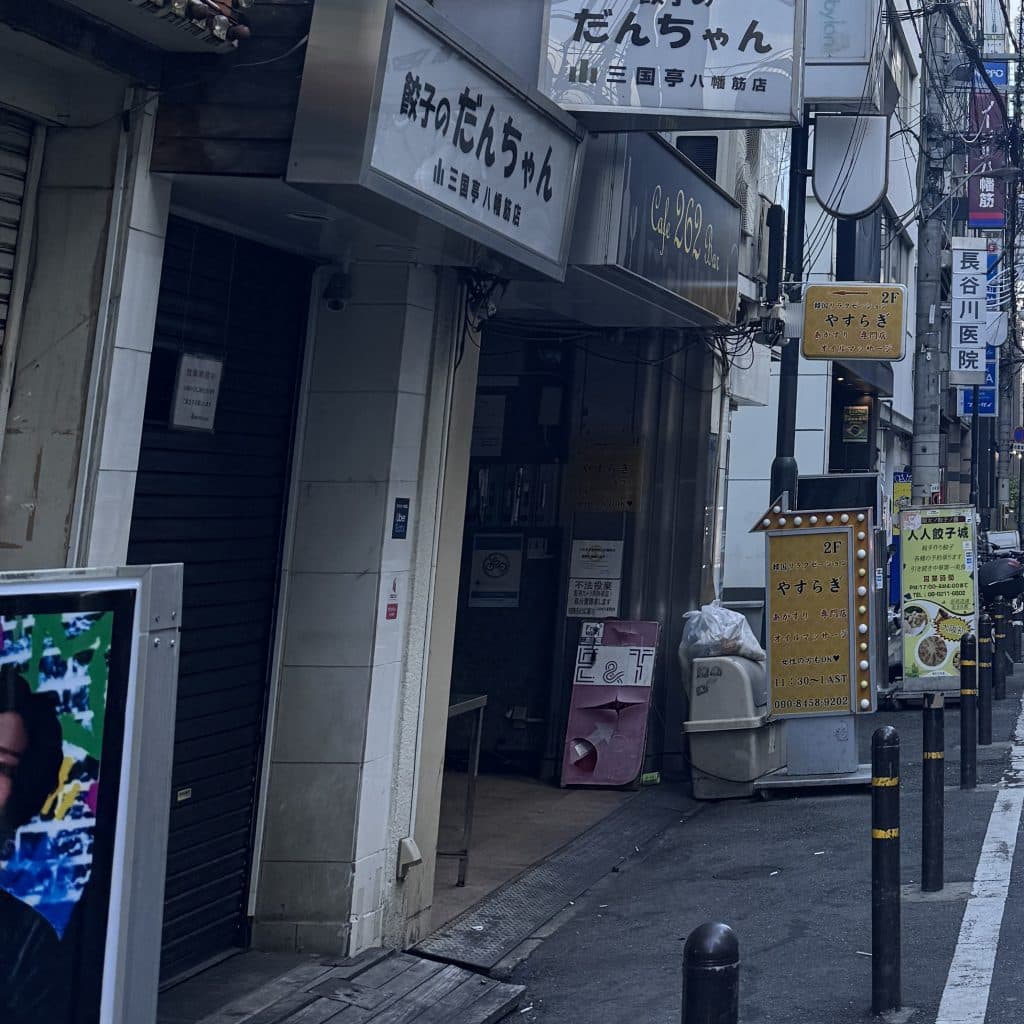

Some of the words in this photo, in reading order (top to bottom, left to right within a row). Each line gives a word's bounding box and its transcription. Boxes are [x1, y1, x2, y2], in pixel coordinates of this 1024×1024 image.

[573, 7, 774, 55] だんちゃん
[673, 189, 703, 261] 262
[881, 291, 900, 304] 2F
[826, 312, 890, 328] やすらぎ
[958, 251, 980, 370] 長谷川医院
[823, 540, 842, 554] 2F
[777, 576, 843, 596] やすらぎ
